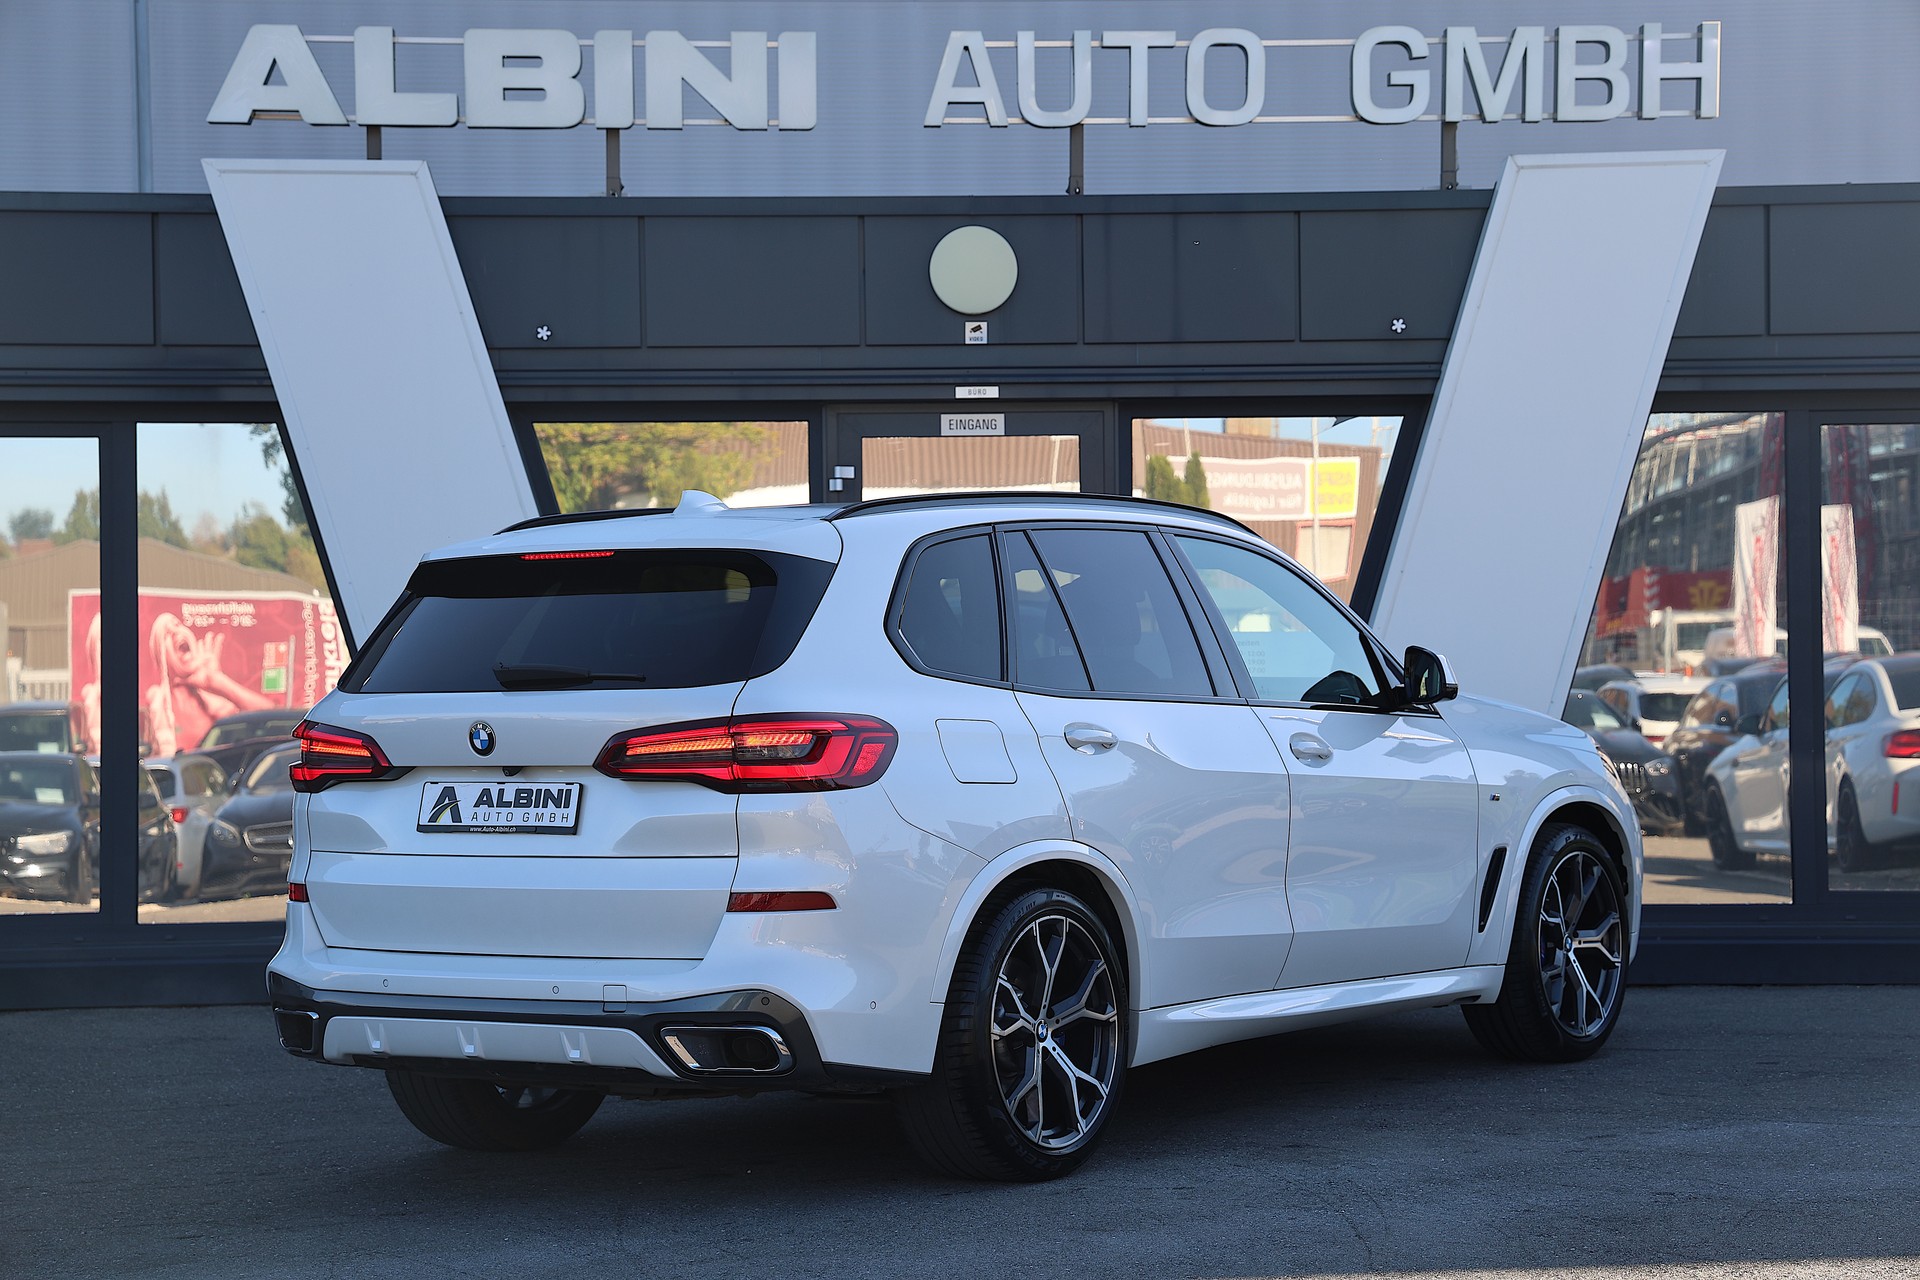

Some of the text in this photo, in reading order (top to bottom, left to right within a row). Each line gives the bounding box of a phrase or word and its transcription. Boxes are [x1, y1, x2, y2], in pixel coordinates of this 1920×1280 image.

[206, 21, 1721, 131] ALBINI AUTO GMBH
[948, 419, 998, 430] EINGANG
[471, 723, 492, 734] BMW
[473, 788, 573, 809] ALBINI
[471, 812, 569, 823] AUTO GMBH
